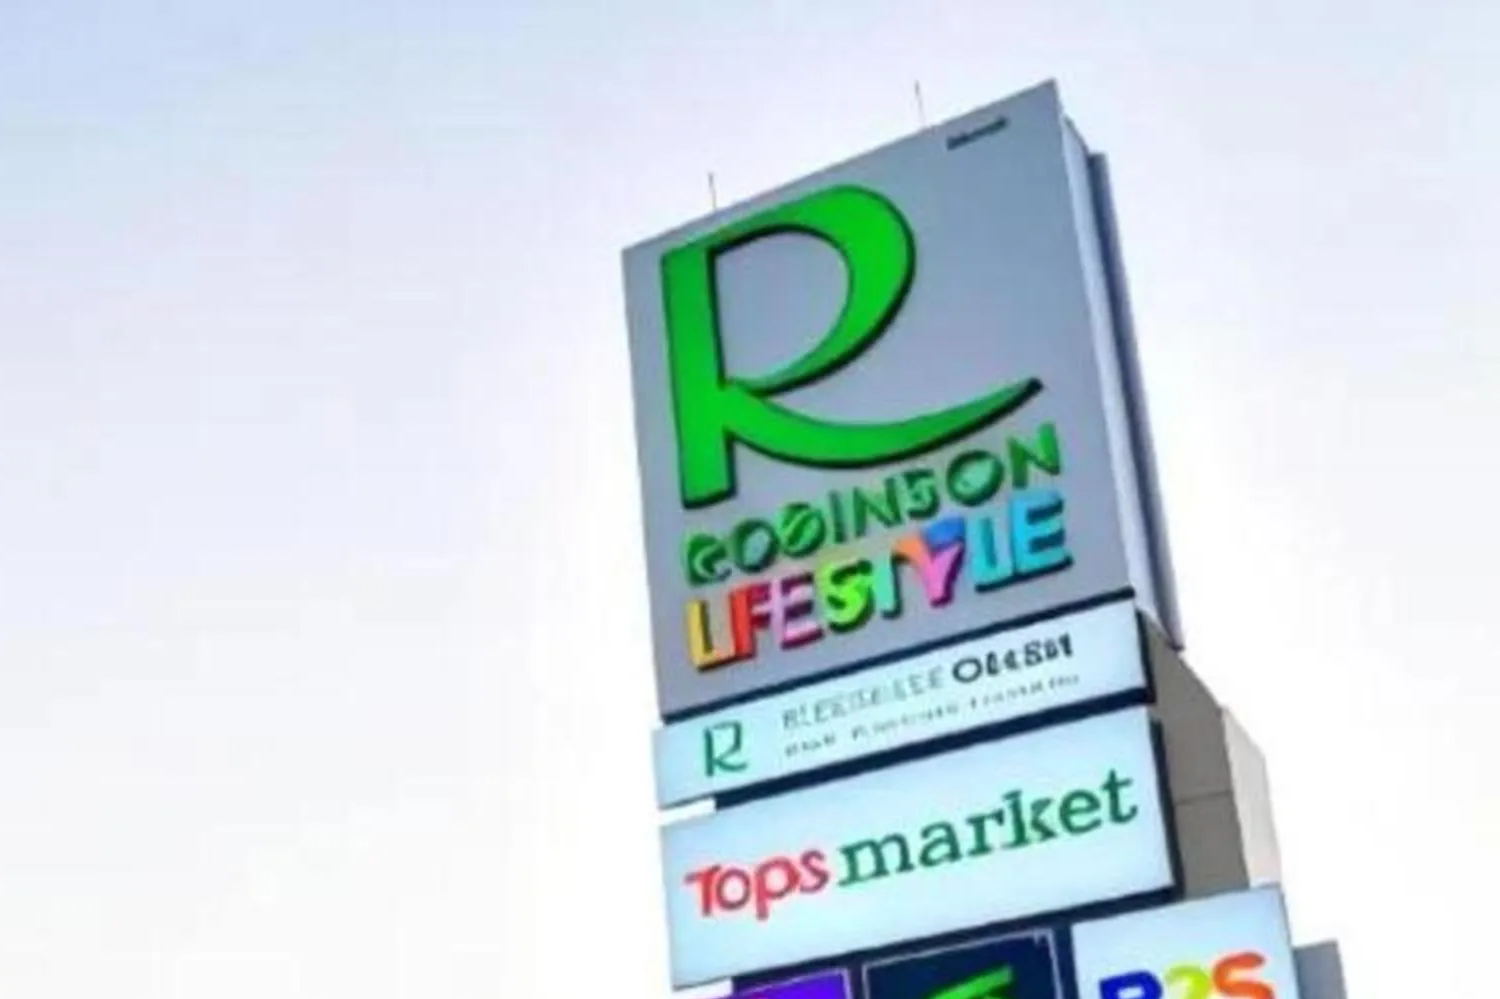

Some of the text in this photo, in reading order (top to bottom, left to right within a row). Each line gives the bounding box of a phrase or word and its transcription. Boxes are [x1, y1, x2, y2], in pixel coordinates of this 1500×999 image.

[660, 184, 1043, 509] R
[685, 768, 1138, 920] Tops market
